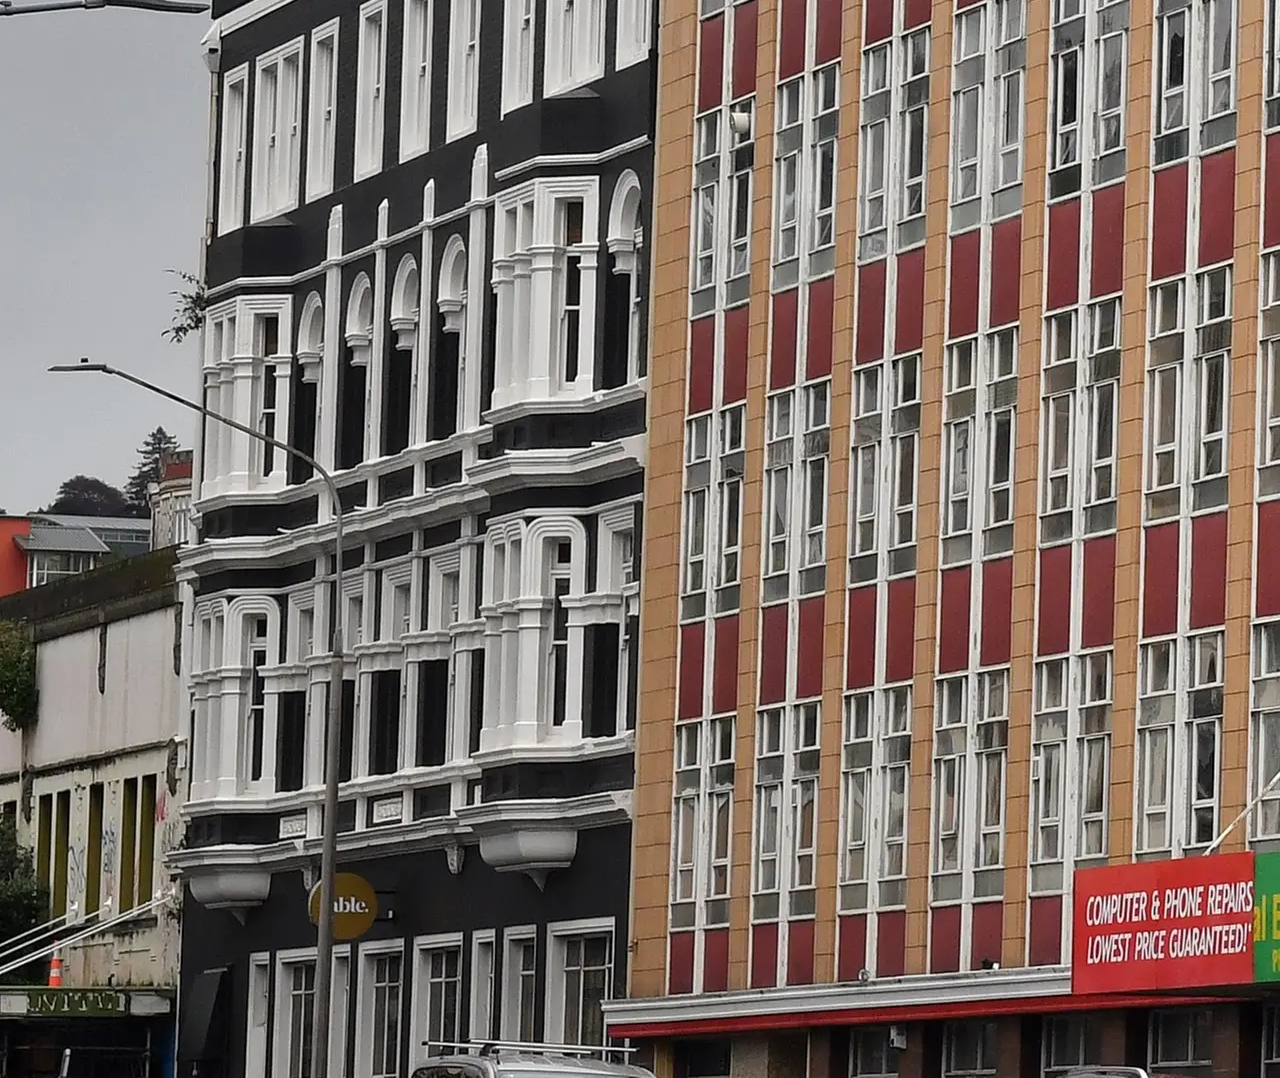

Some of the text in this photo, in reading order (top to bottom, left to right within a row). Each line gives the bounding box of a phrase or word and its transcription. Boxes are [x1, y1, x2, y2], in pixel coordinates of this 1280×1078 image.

[1086, 881, 1254, 927] COMPUTER & PHONE REPAIRS
[1087, 932, 1132, 964] LOWEST
[1135, 930, 1166, 960] PRICE
